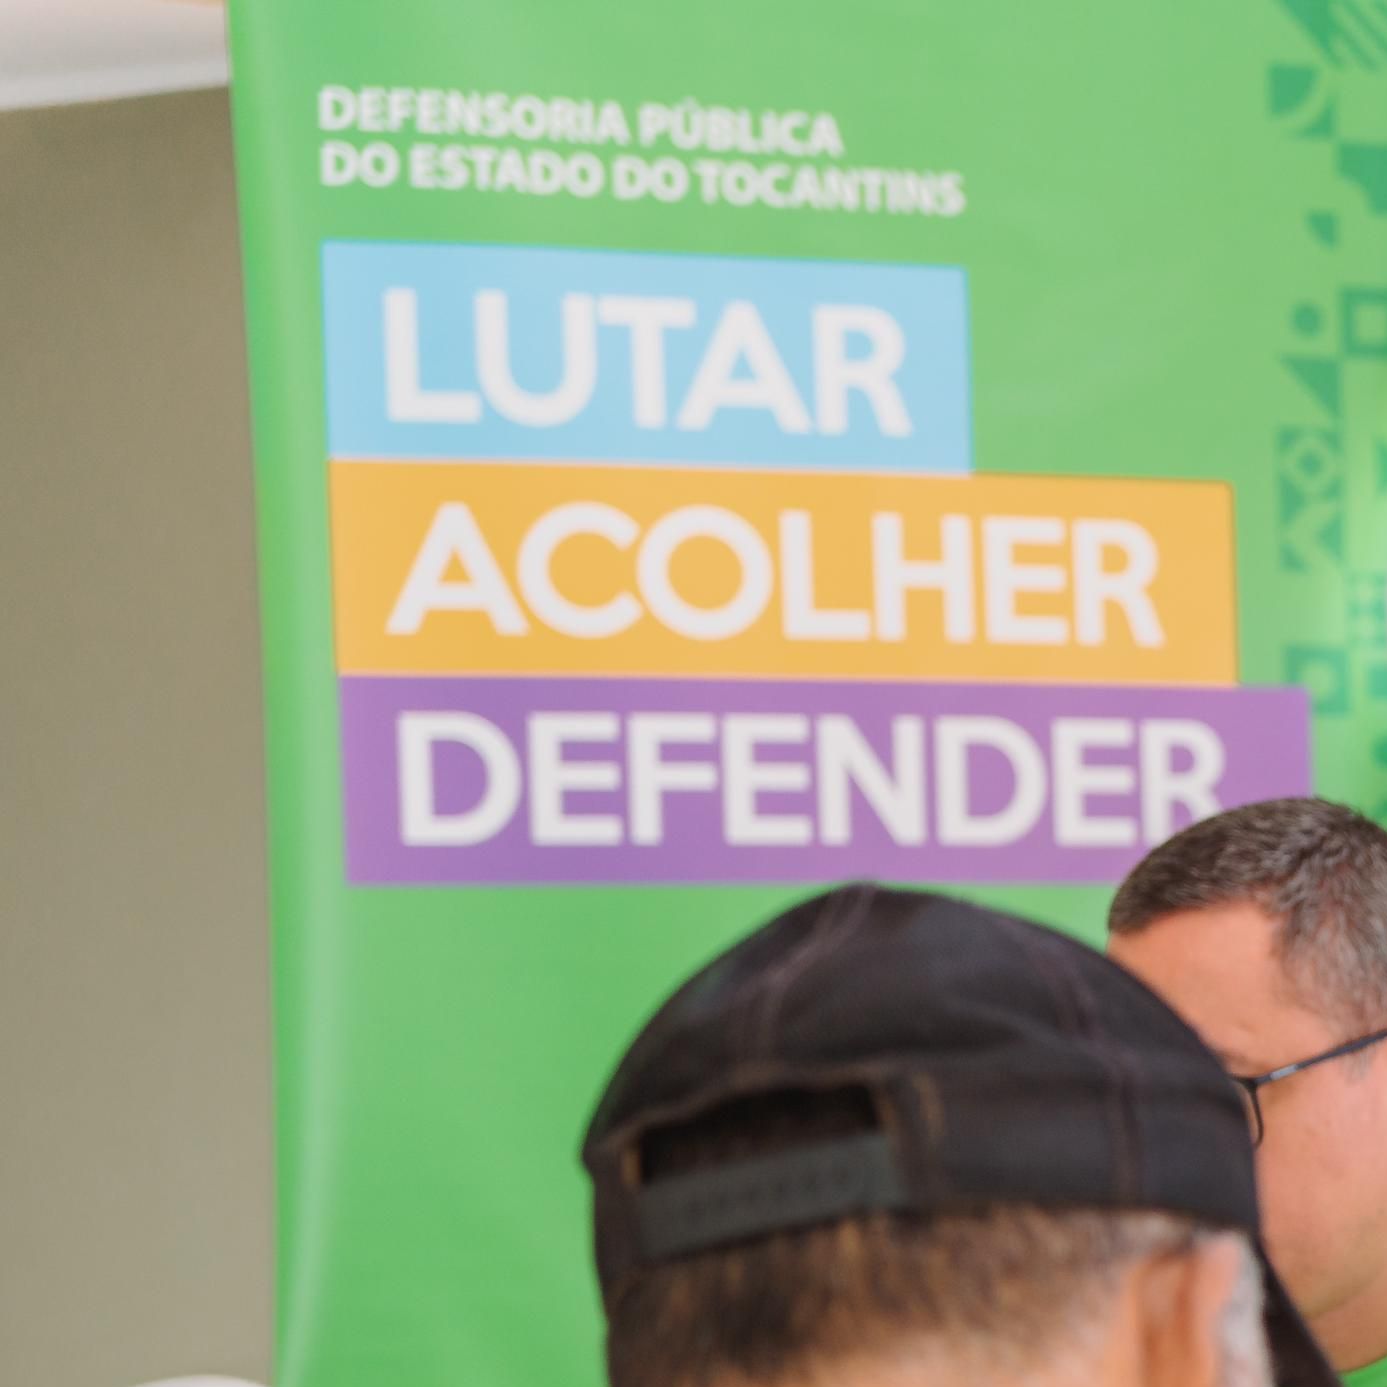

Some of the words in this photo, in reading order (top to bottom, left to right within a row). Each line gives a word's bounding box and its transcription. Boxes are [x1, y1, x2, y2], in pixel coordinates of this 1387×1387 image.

[318, 85, 629, 145] DEFENSORIA
[638, 96, 846, 157] PÚBLICA
[319, 140, 401, 188] DO
[408, 144, 604, 198] ESTADO
[612, 155, 690, 203] DO
[693, 158, 967, 217] TOCANTINS
[383, 286, 913, 438] LUTAR
[385, 500, 1166, 648] ACOLHER
[397, 711, 1226, 847] DEFENDER
